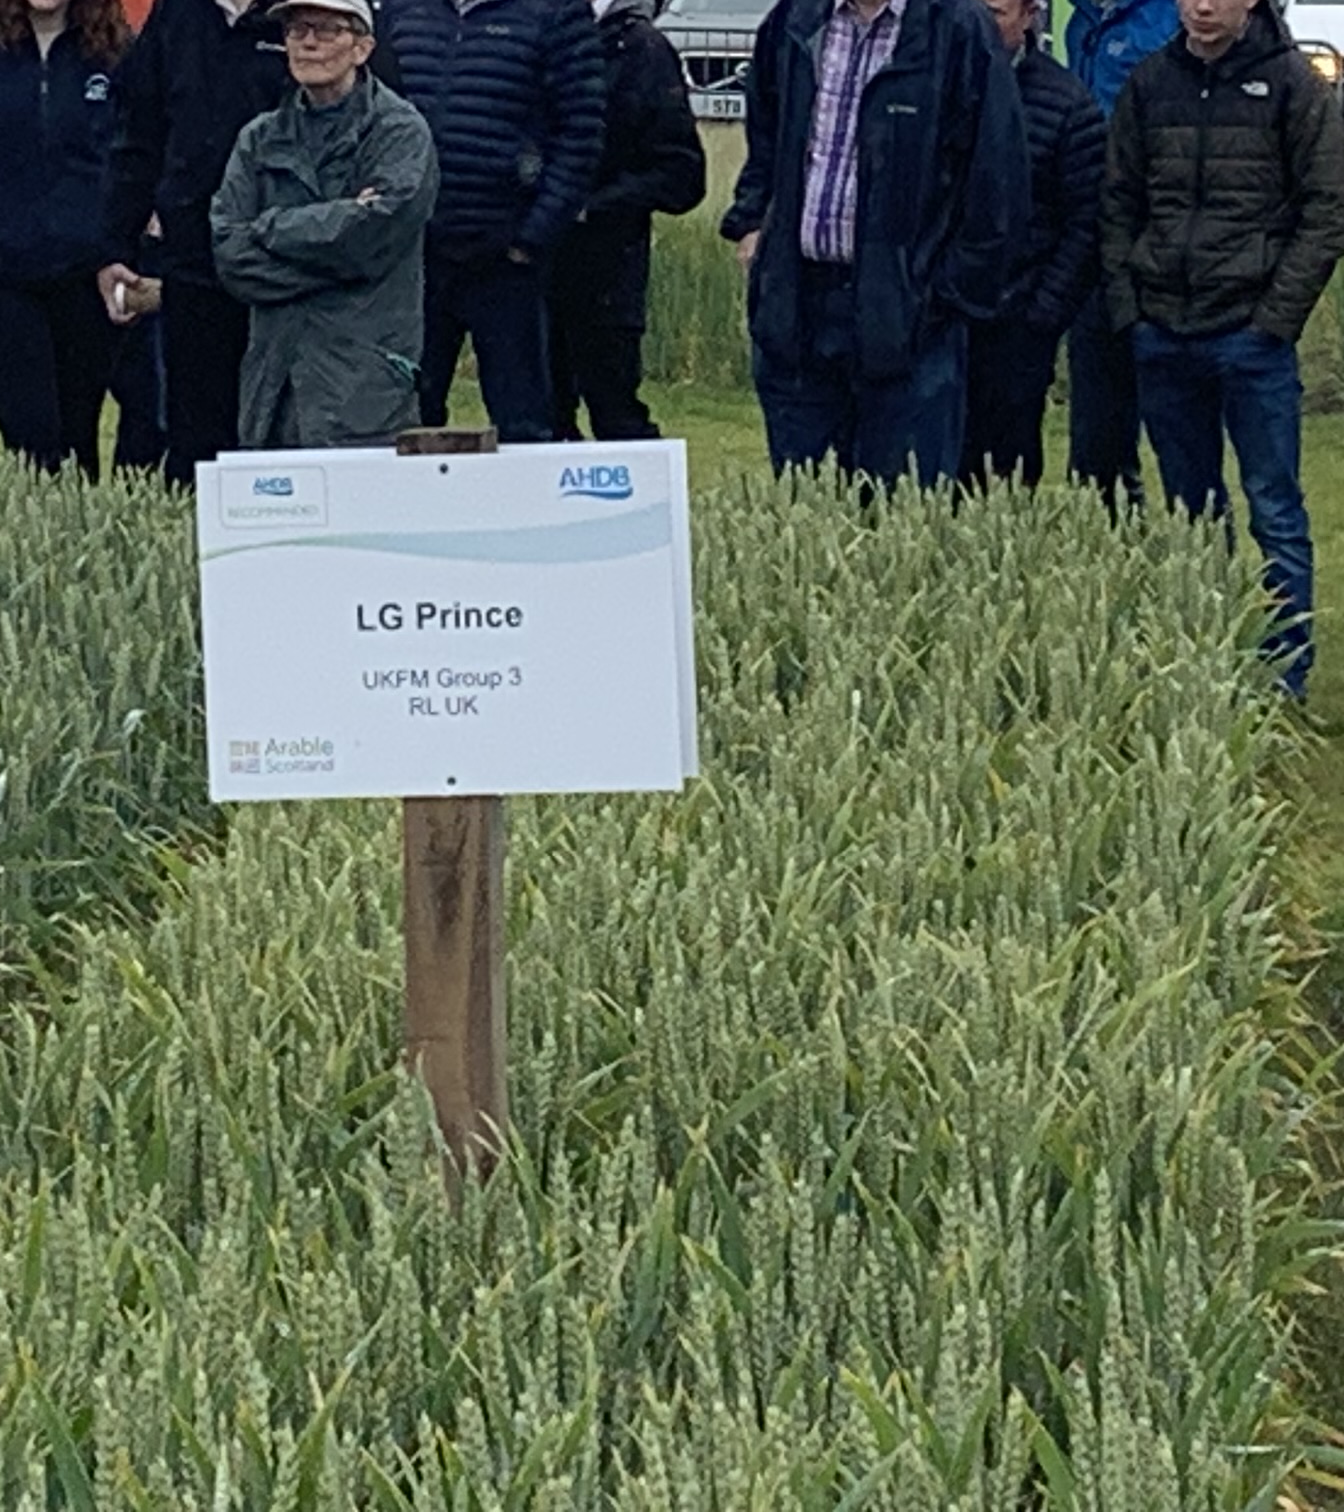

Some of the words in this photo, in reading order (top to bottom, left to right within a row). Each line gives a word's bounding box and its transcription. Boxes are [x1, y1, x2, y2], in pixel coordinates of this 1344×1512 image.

[559, 465, 631, 488] AHDB
[356, 603, 404, 632] LG
[417, 601, 523, 630] Prince
[363, 669, 430, 690] UKFM
[437, 668, 503, 694] Group
[508, 667, 522, 686] 3
[409, 697, 440, 717] RL
[445, 696, 479, 716] UK
[264, 737, 334, 757] Arable
